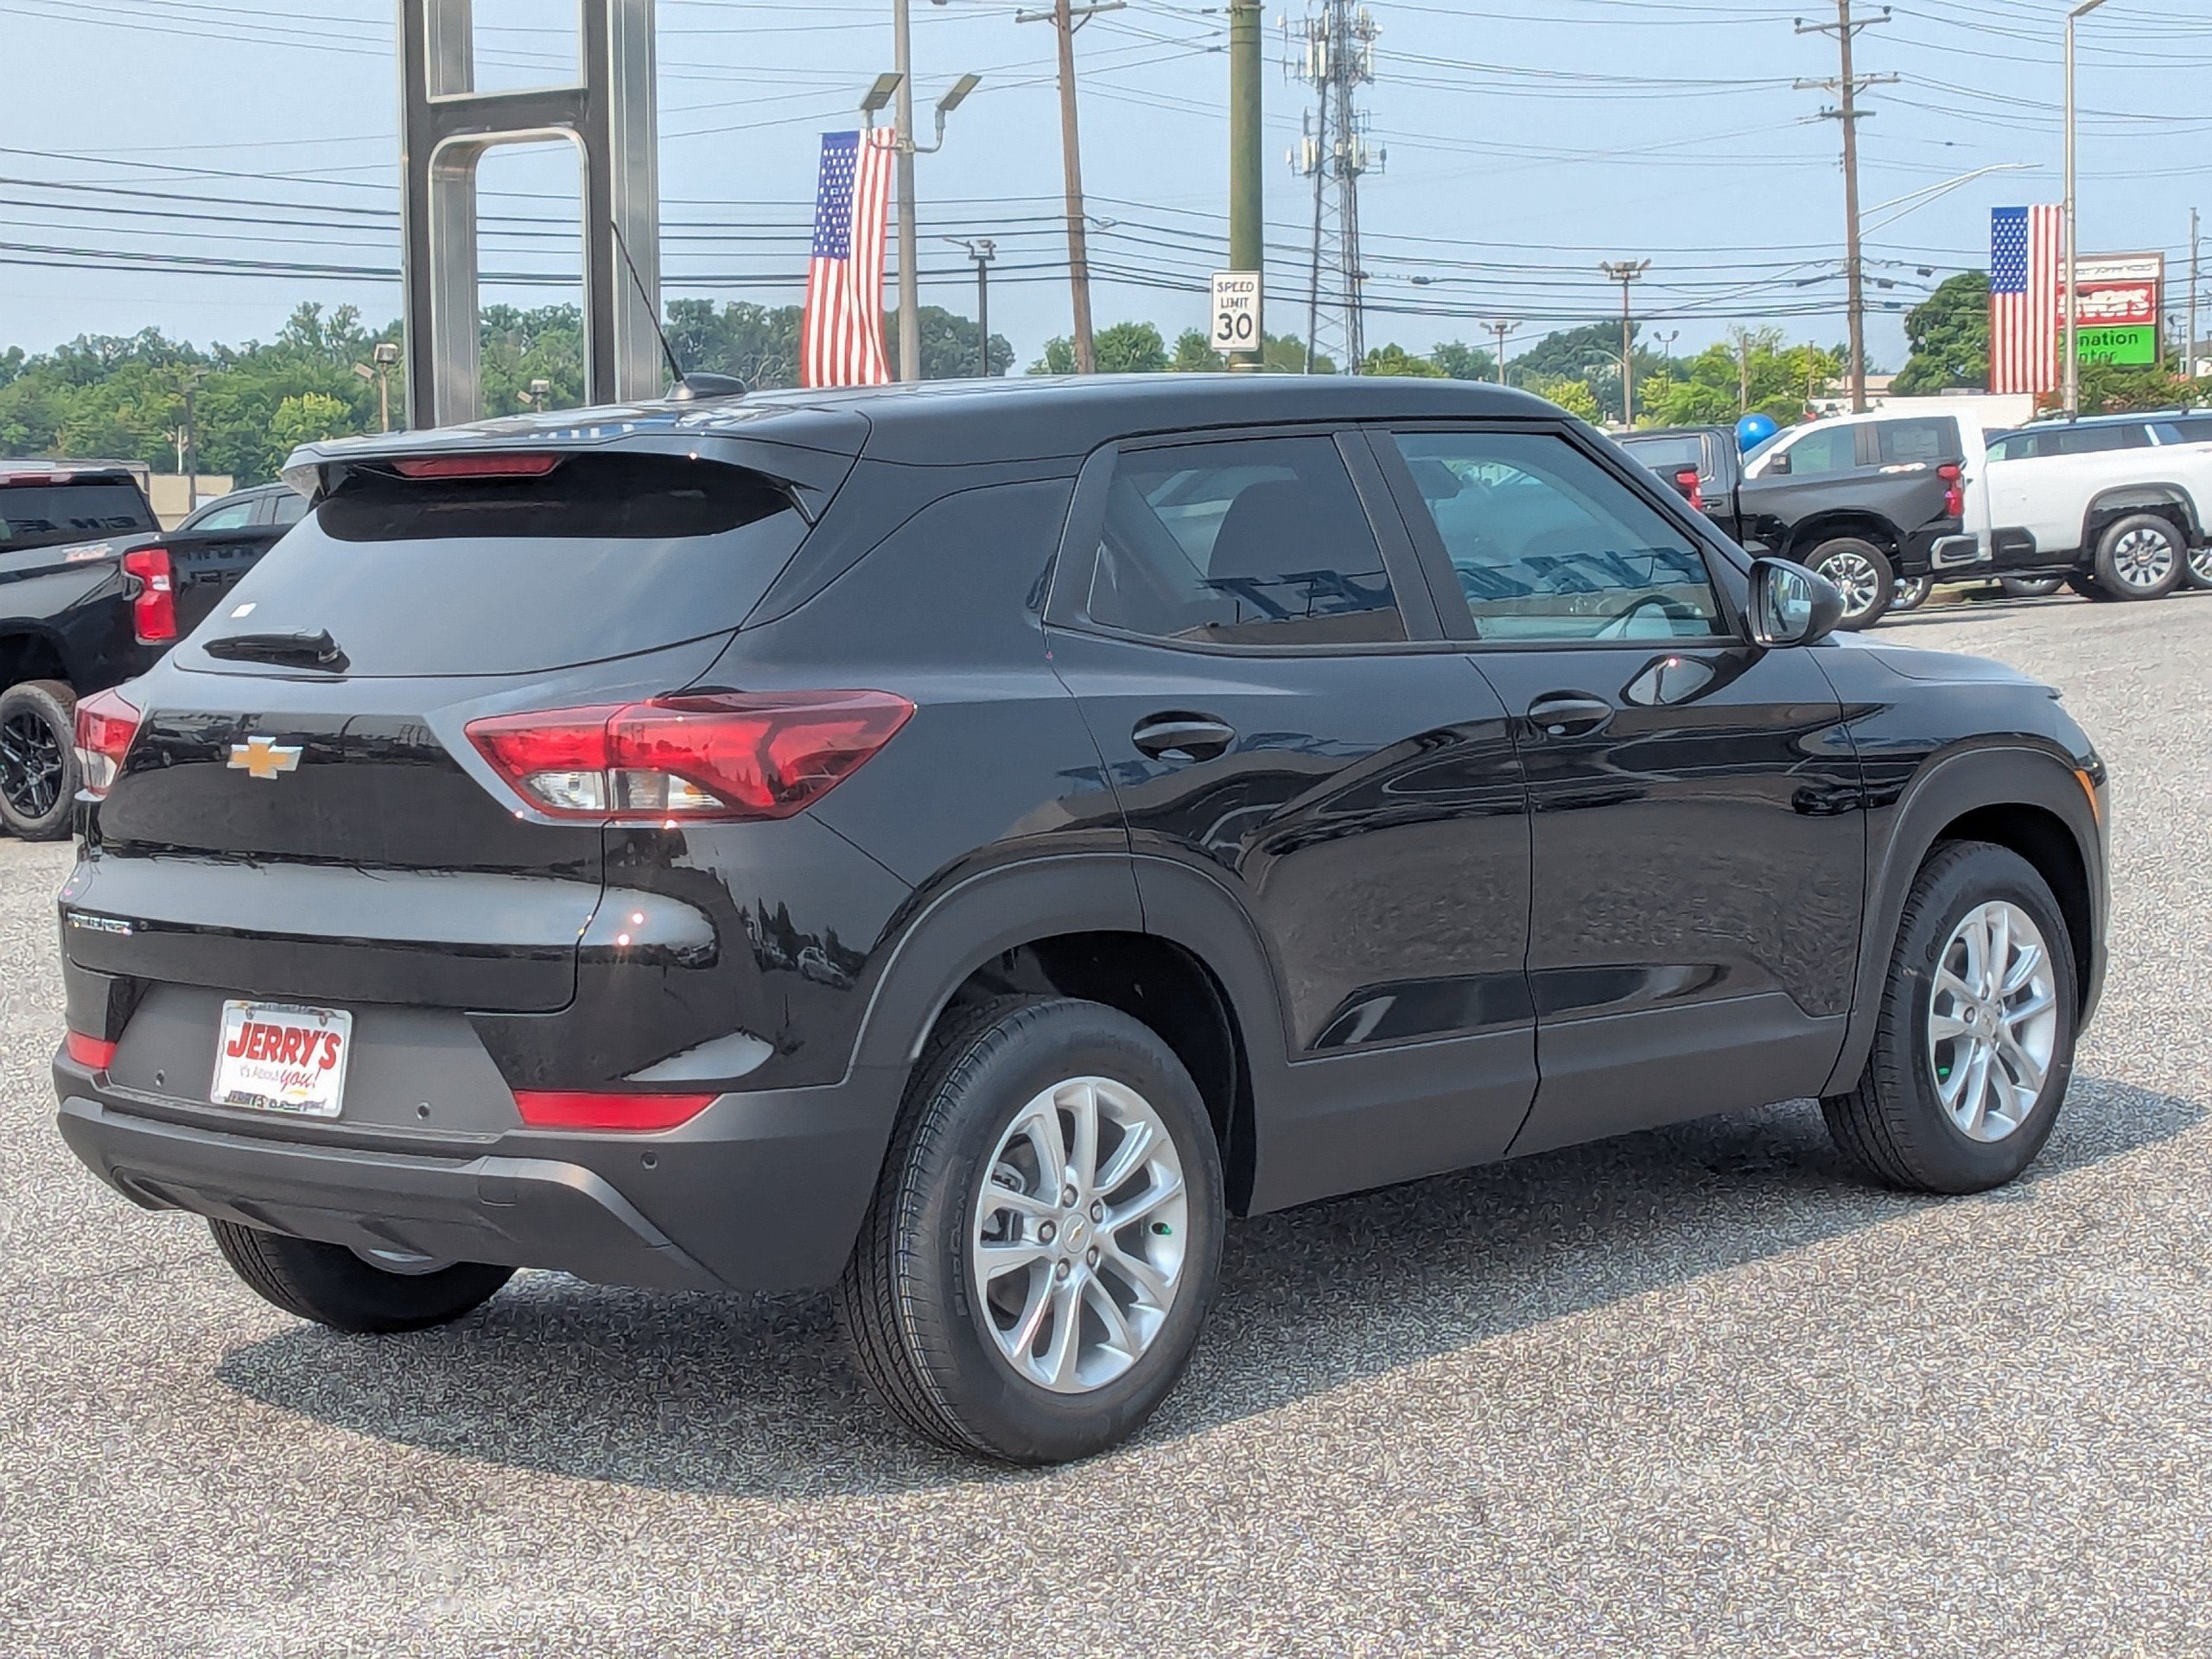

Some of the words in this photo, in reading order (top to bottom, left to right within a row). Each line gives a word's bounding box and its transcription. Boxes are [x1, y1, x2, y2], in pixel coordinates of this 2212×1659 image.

[1217, 281, 1255, 293] SPEED
[1220, 297, 1249, 308] LIMIT
[1217, 313, 1252, 340] 30
[2068, 329, 2139, 347] nation
[2068, 349, 2119, 364] nter
[226, 1021, 342, 1070] JERRY'S
[280, 1065, 321, 1092] you!
